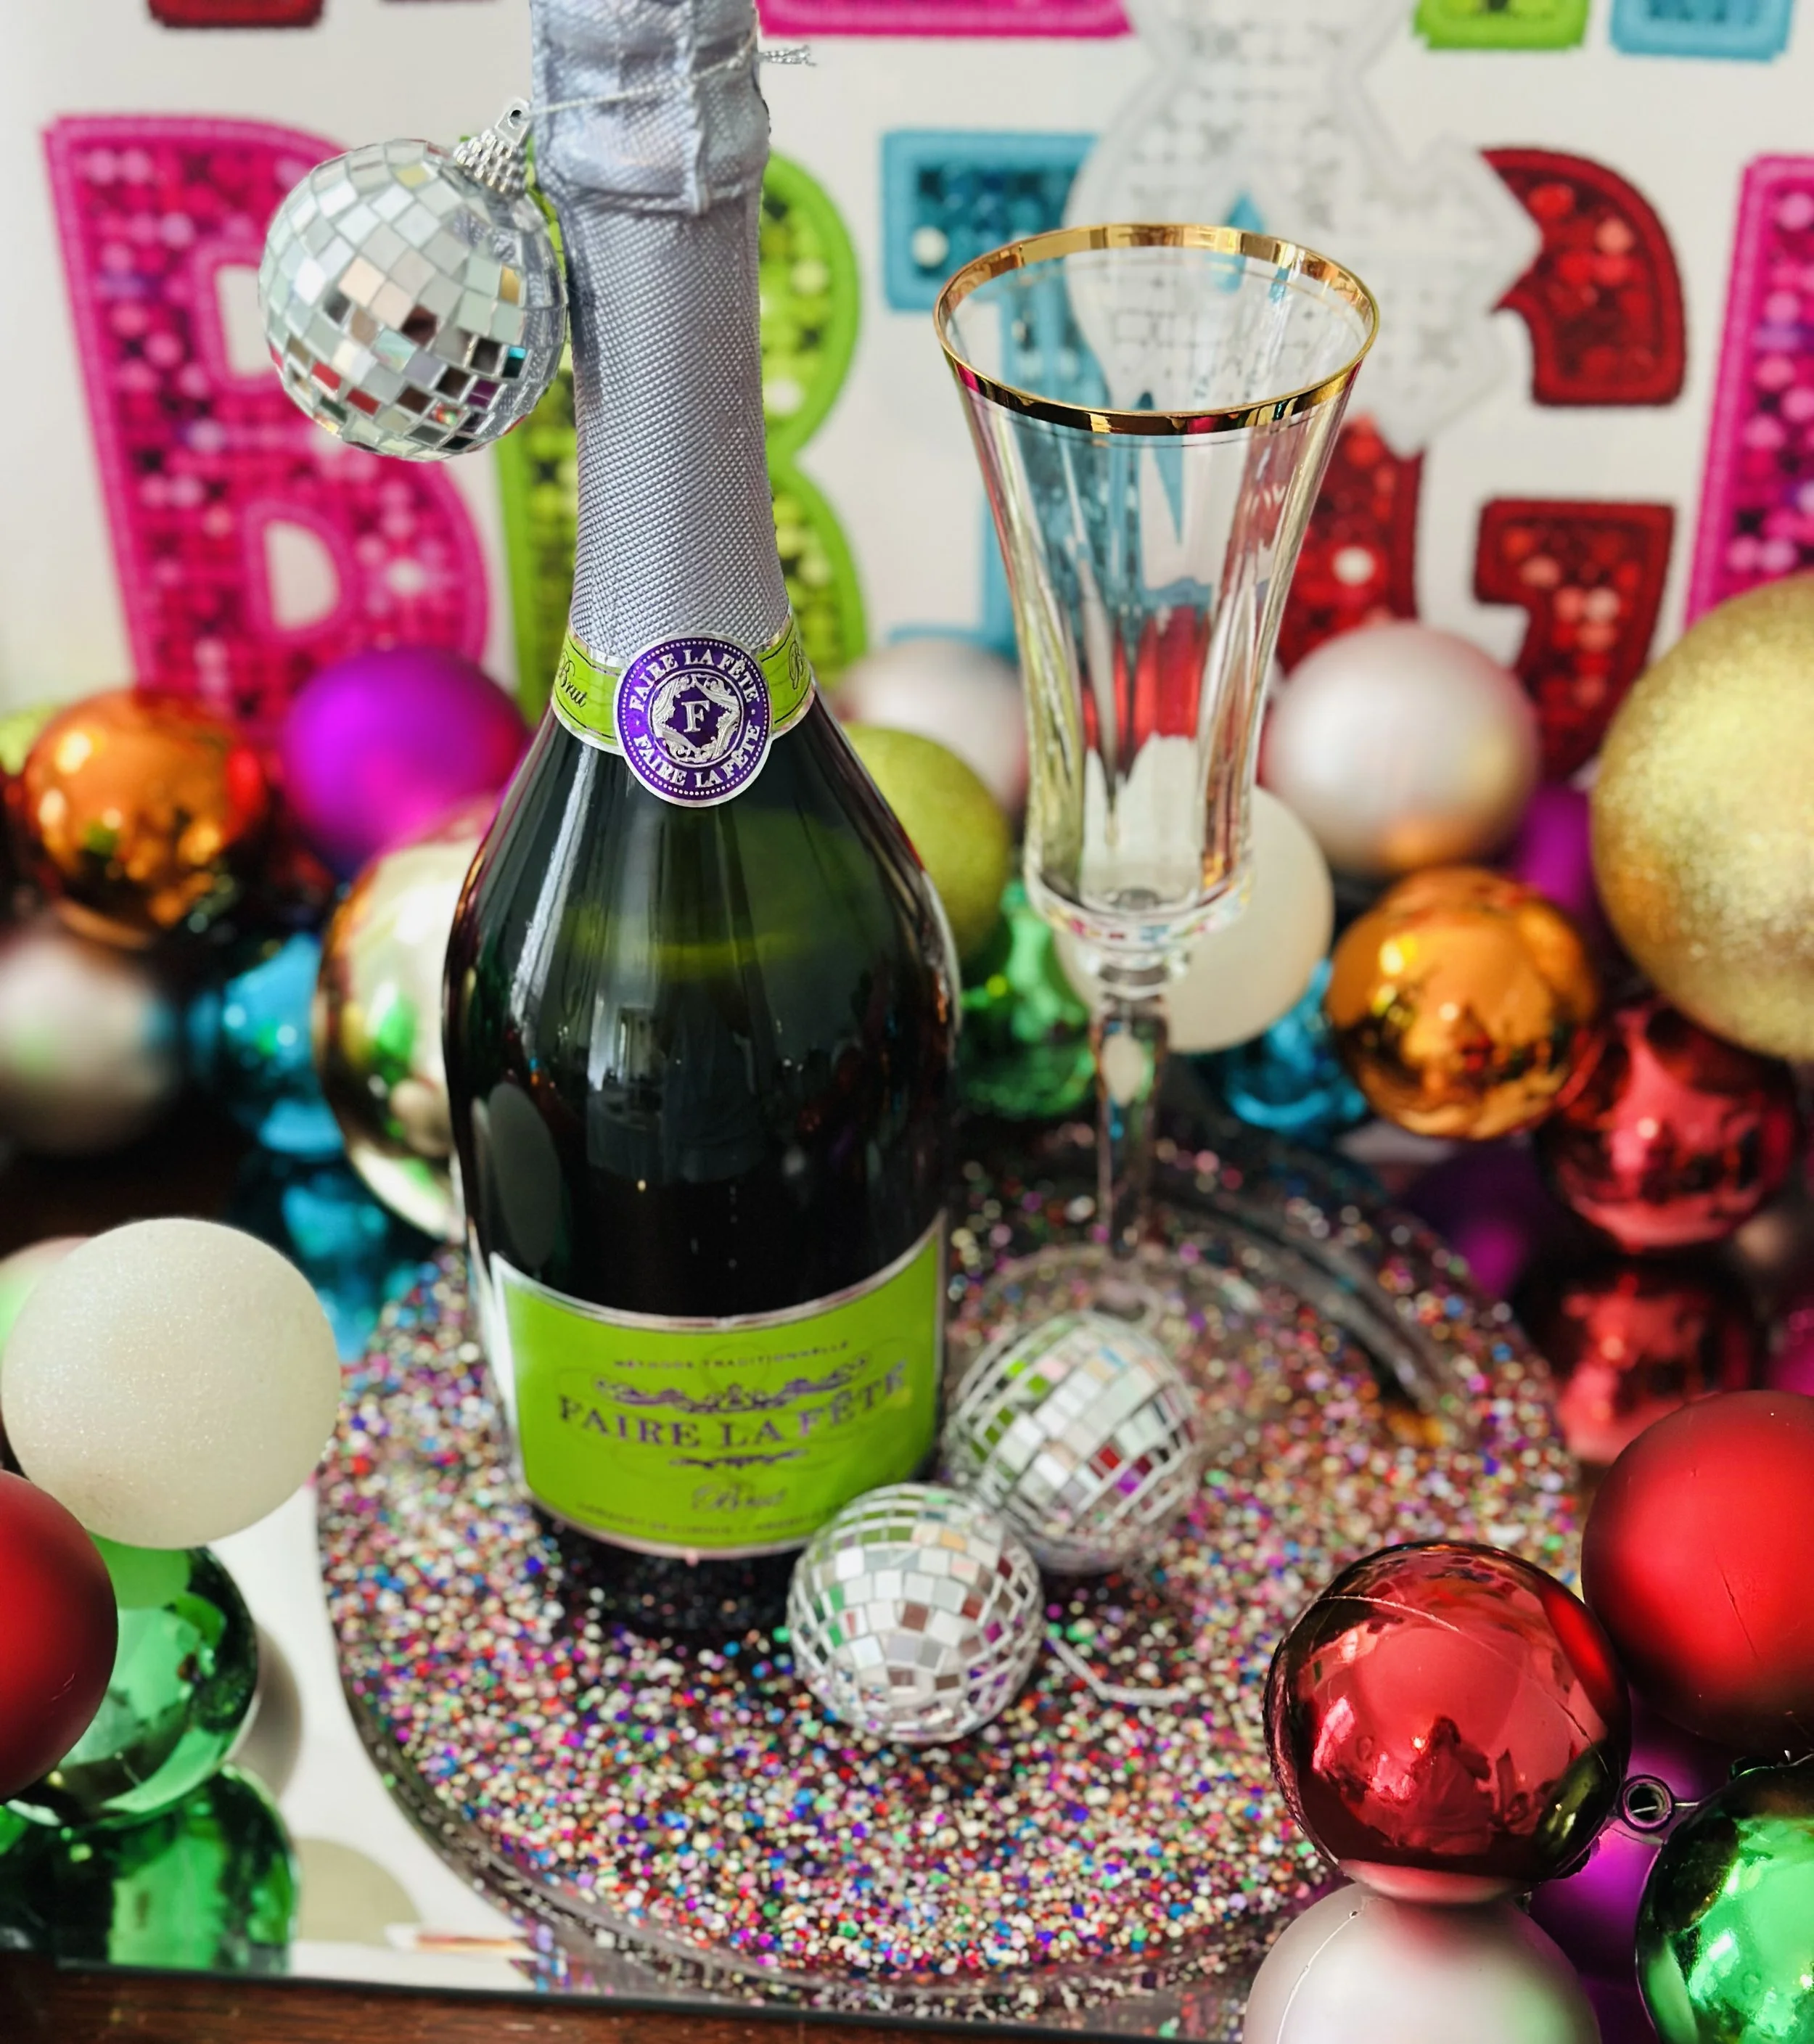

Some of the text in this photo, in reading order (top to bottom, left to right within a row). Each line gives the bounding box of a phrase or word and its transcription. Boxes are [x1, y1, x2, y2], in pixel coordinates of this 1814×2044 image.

[559, 649, 588, 707] Brut
[629, 653, 678, 713] FAIRE
[683, 649, 714, 665] LA
[718, 652, 760, 703] FÊTE
[681, 700, 710, 733] F
[633, 734, 687, 786] FAIRE
[694, 770, 723, 788] LA
[557, 1393, 700, 1448] FAIRE
[718, 1419, 784, 1448] LA
[691, 1482, 788, 1512] Brut
